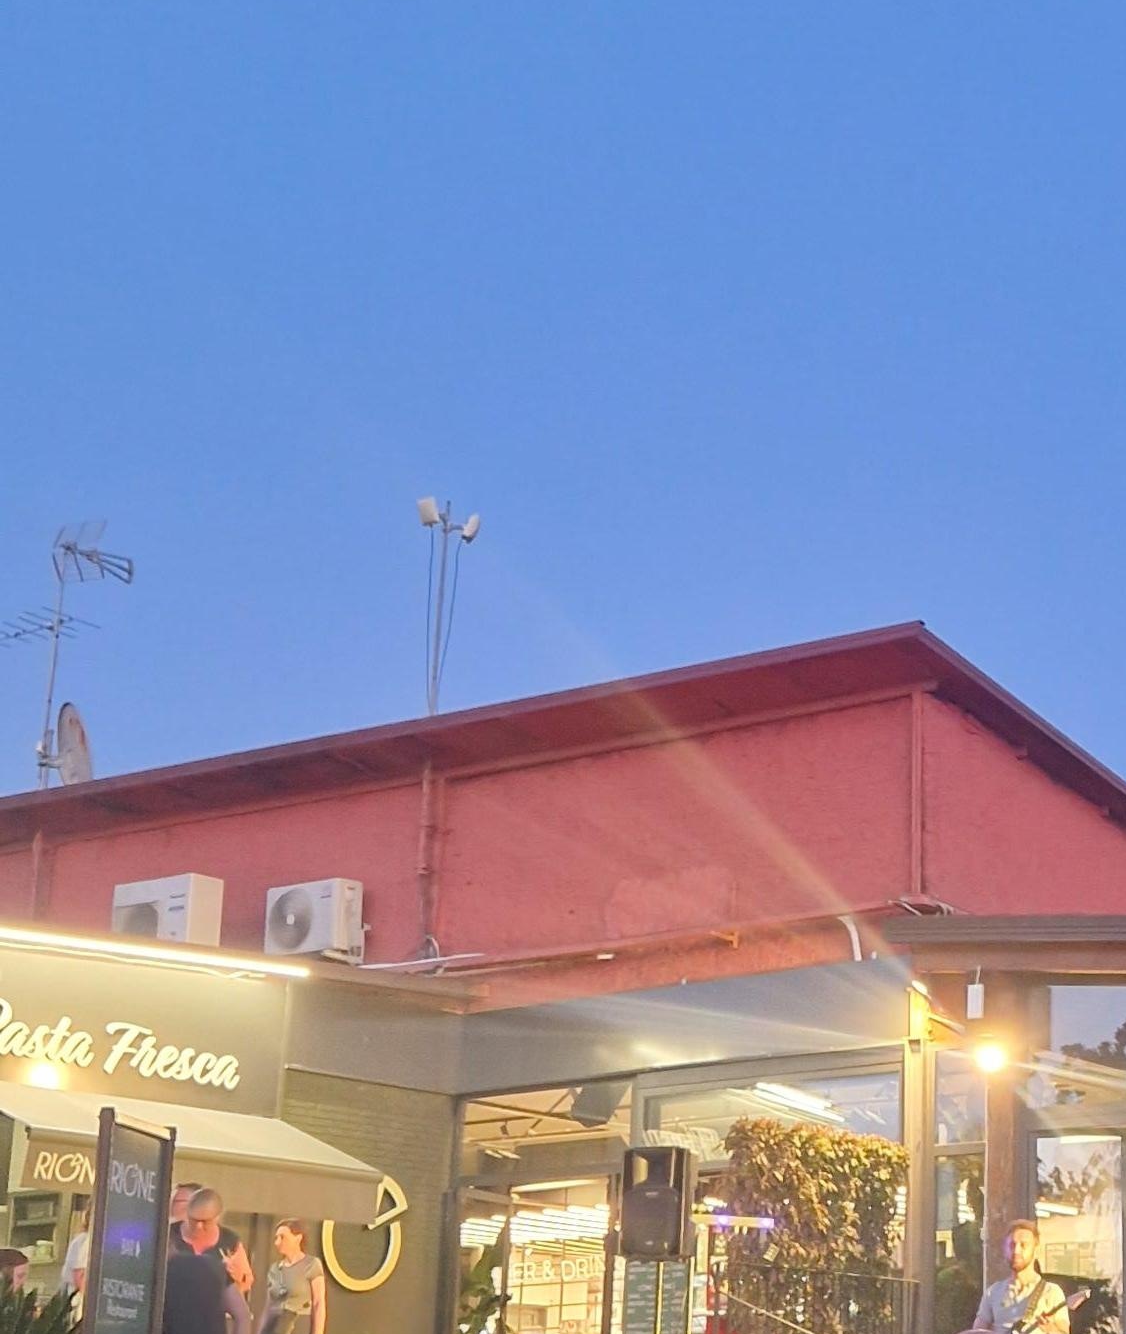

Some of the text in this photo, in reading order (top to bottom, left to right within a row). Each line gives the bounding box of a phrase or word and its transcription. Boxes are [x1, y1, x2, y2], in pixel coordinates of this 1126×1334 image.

[103, 1021, 241, 1090] Fresca
[34, 1151, 96, 1187] RION
[109, 1160, 156, 1203] RIONE
[543, 1259, 555, 1281] &
